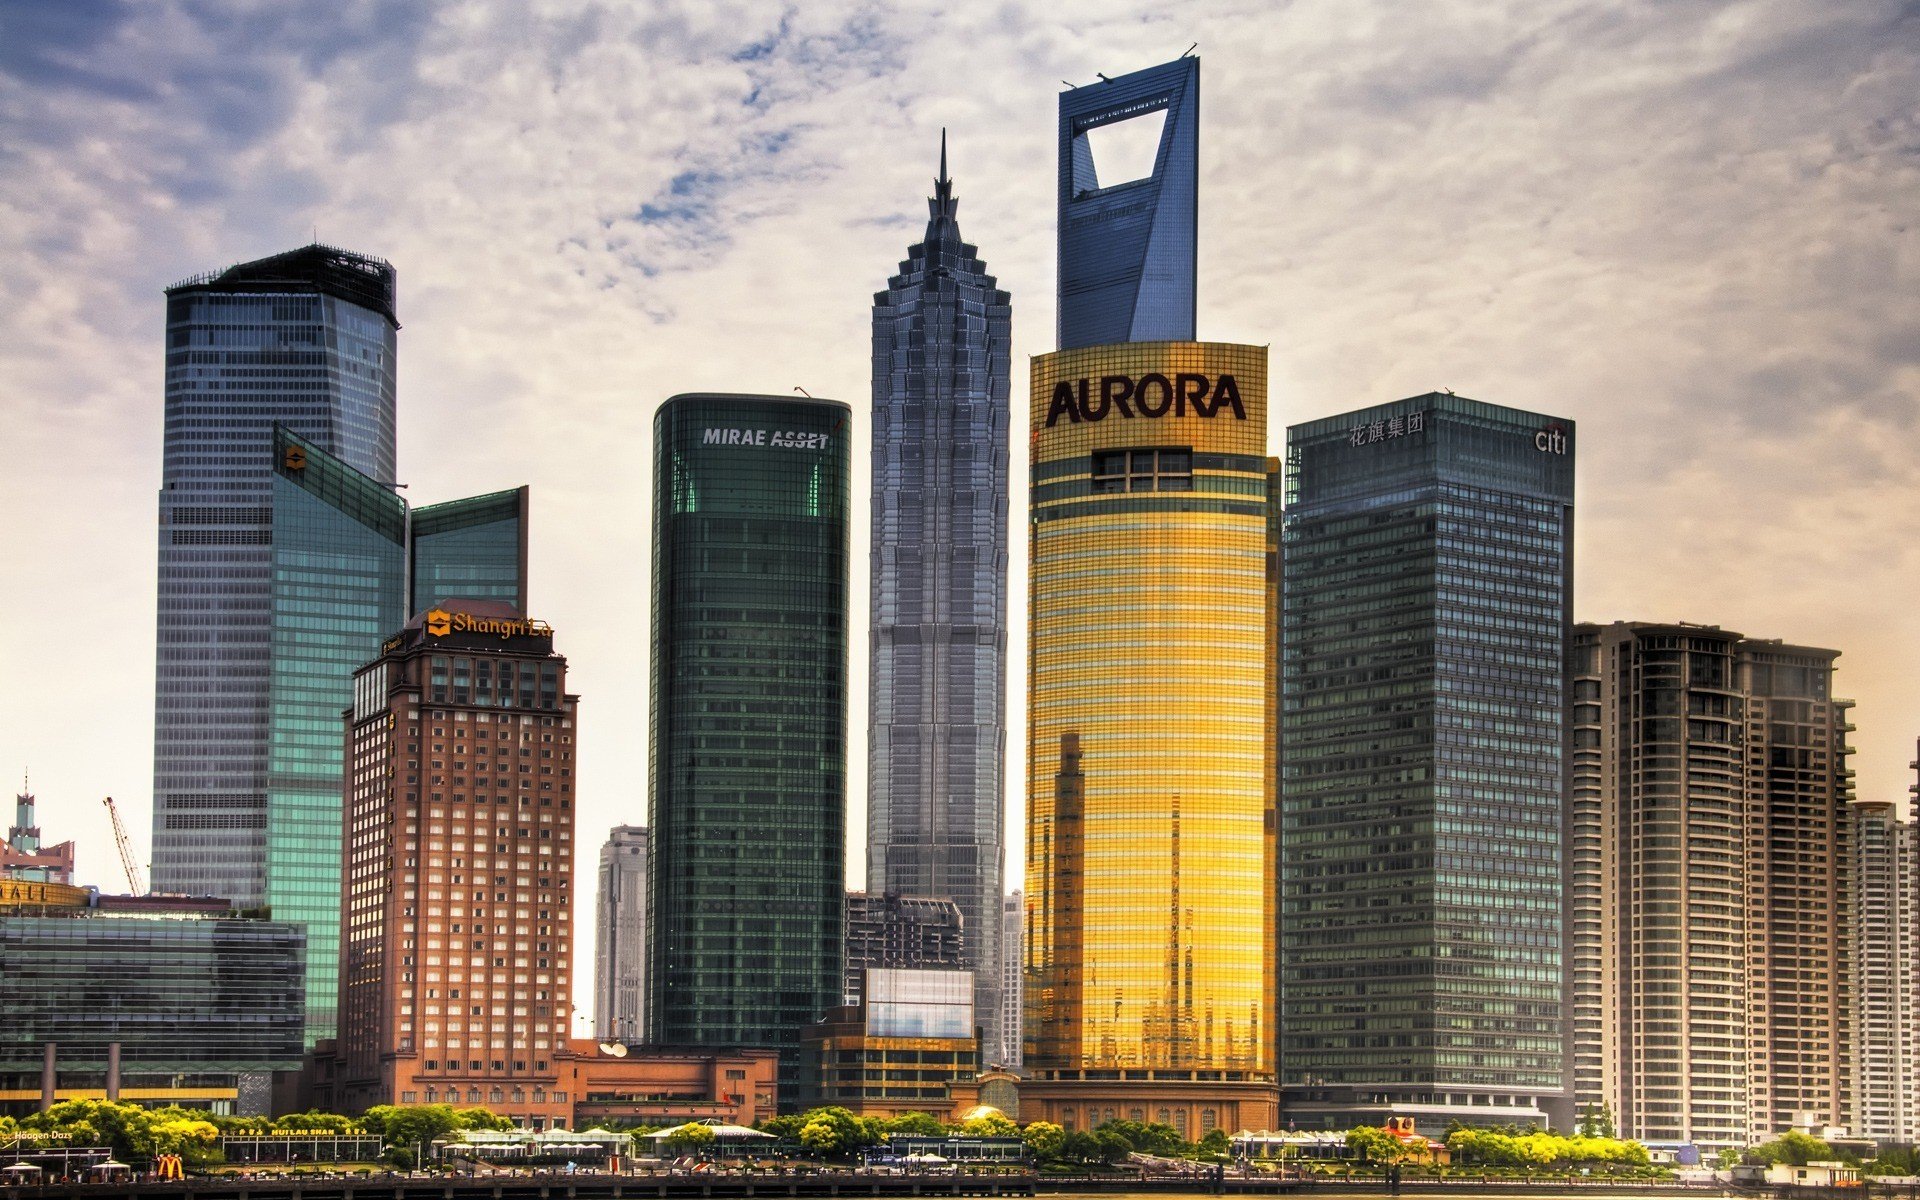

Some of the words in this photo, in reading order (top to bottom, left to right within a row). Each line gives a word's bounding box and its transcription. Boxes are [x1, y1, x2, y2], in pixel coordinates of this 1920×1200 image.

[1045, 373, 1247, 427] AURORA
[702, 428, 766, 446] MIRAE
[769, 430, 829, 450] ASSET
[1350, 411, 1424, 447] 花旗集团
[1535, 428, 1567, 455] citi
